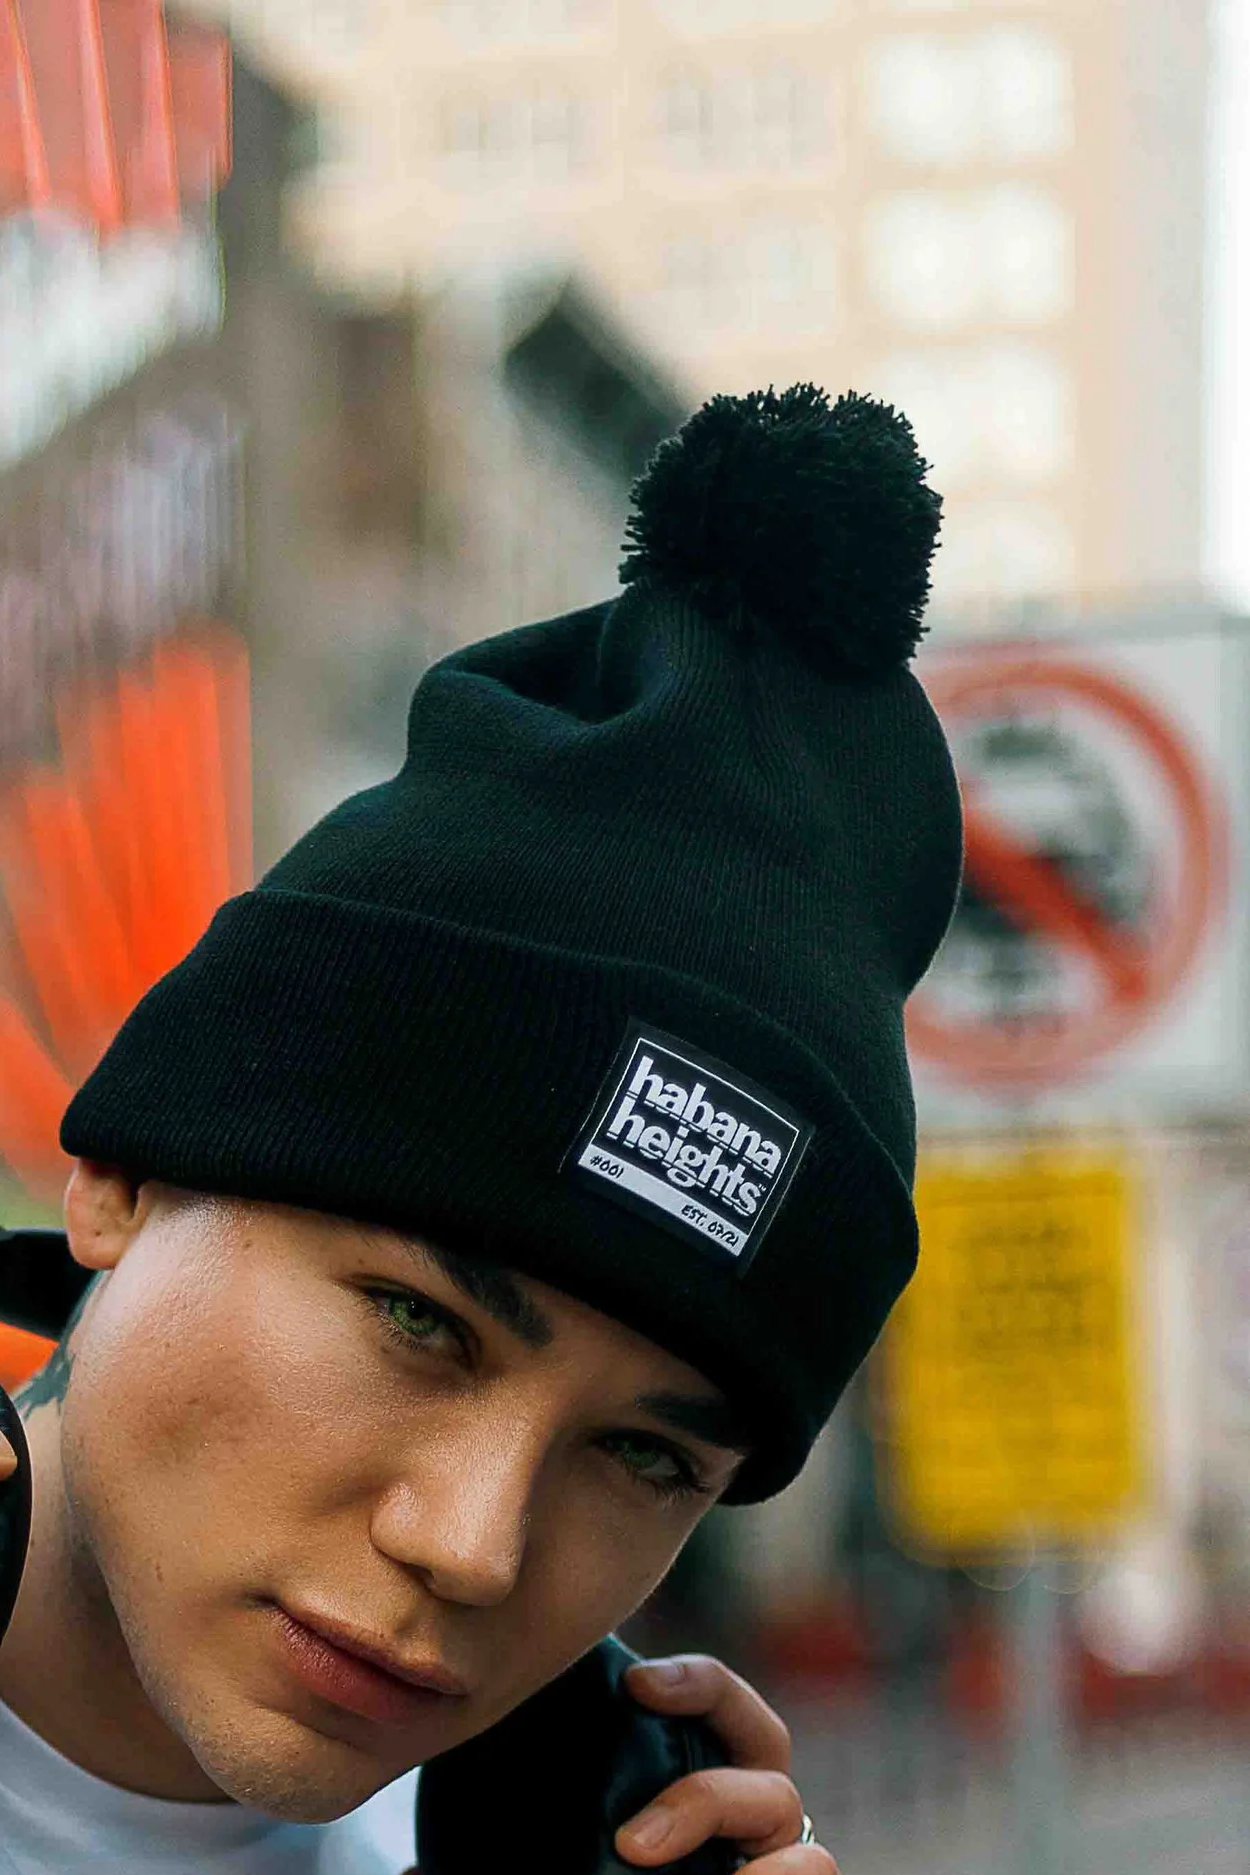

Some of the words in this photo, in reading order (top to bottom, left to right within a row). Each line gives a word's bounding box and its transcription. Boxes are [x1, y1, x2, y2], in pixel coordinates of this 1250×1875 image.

[605, 1096, 761, 1217] heights
[626, 1055, 782, 1179] habana
[589, 1155, 625, 1179] #001
[681, 1204, 708, 1226] EST.
